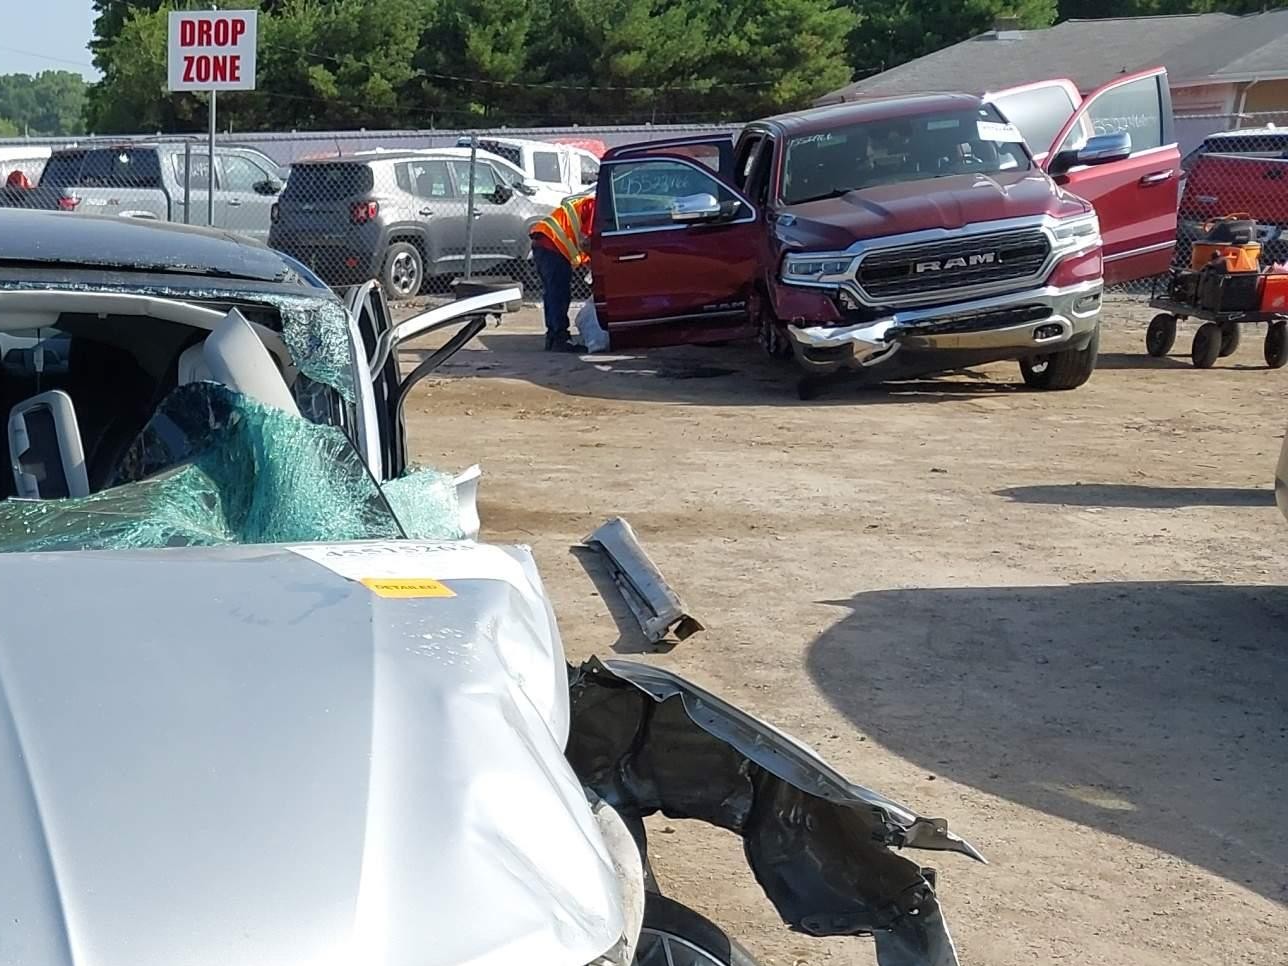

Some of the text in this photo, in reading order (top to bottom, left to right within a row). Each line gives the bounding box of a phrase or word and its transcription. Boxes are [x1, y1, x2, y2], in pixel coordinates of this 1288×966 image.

[180, 18, 246, 48] DROP
[182, 55, 241, 83] ZONE
[916, 252, 996, 273] RAM
